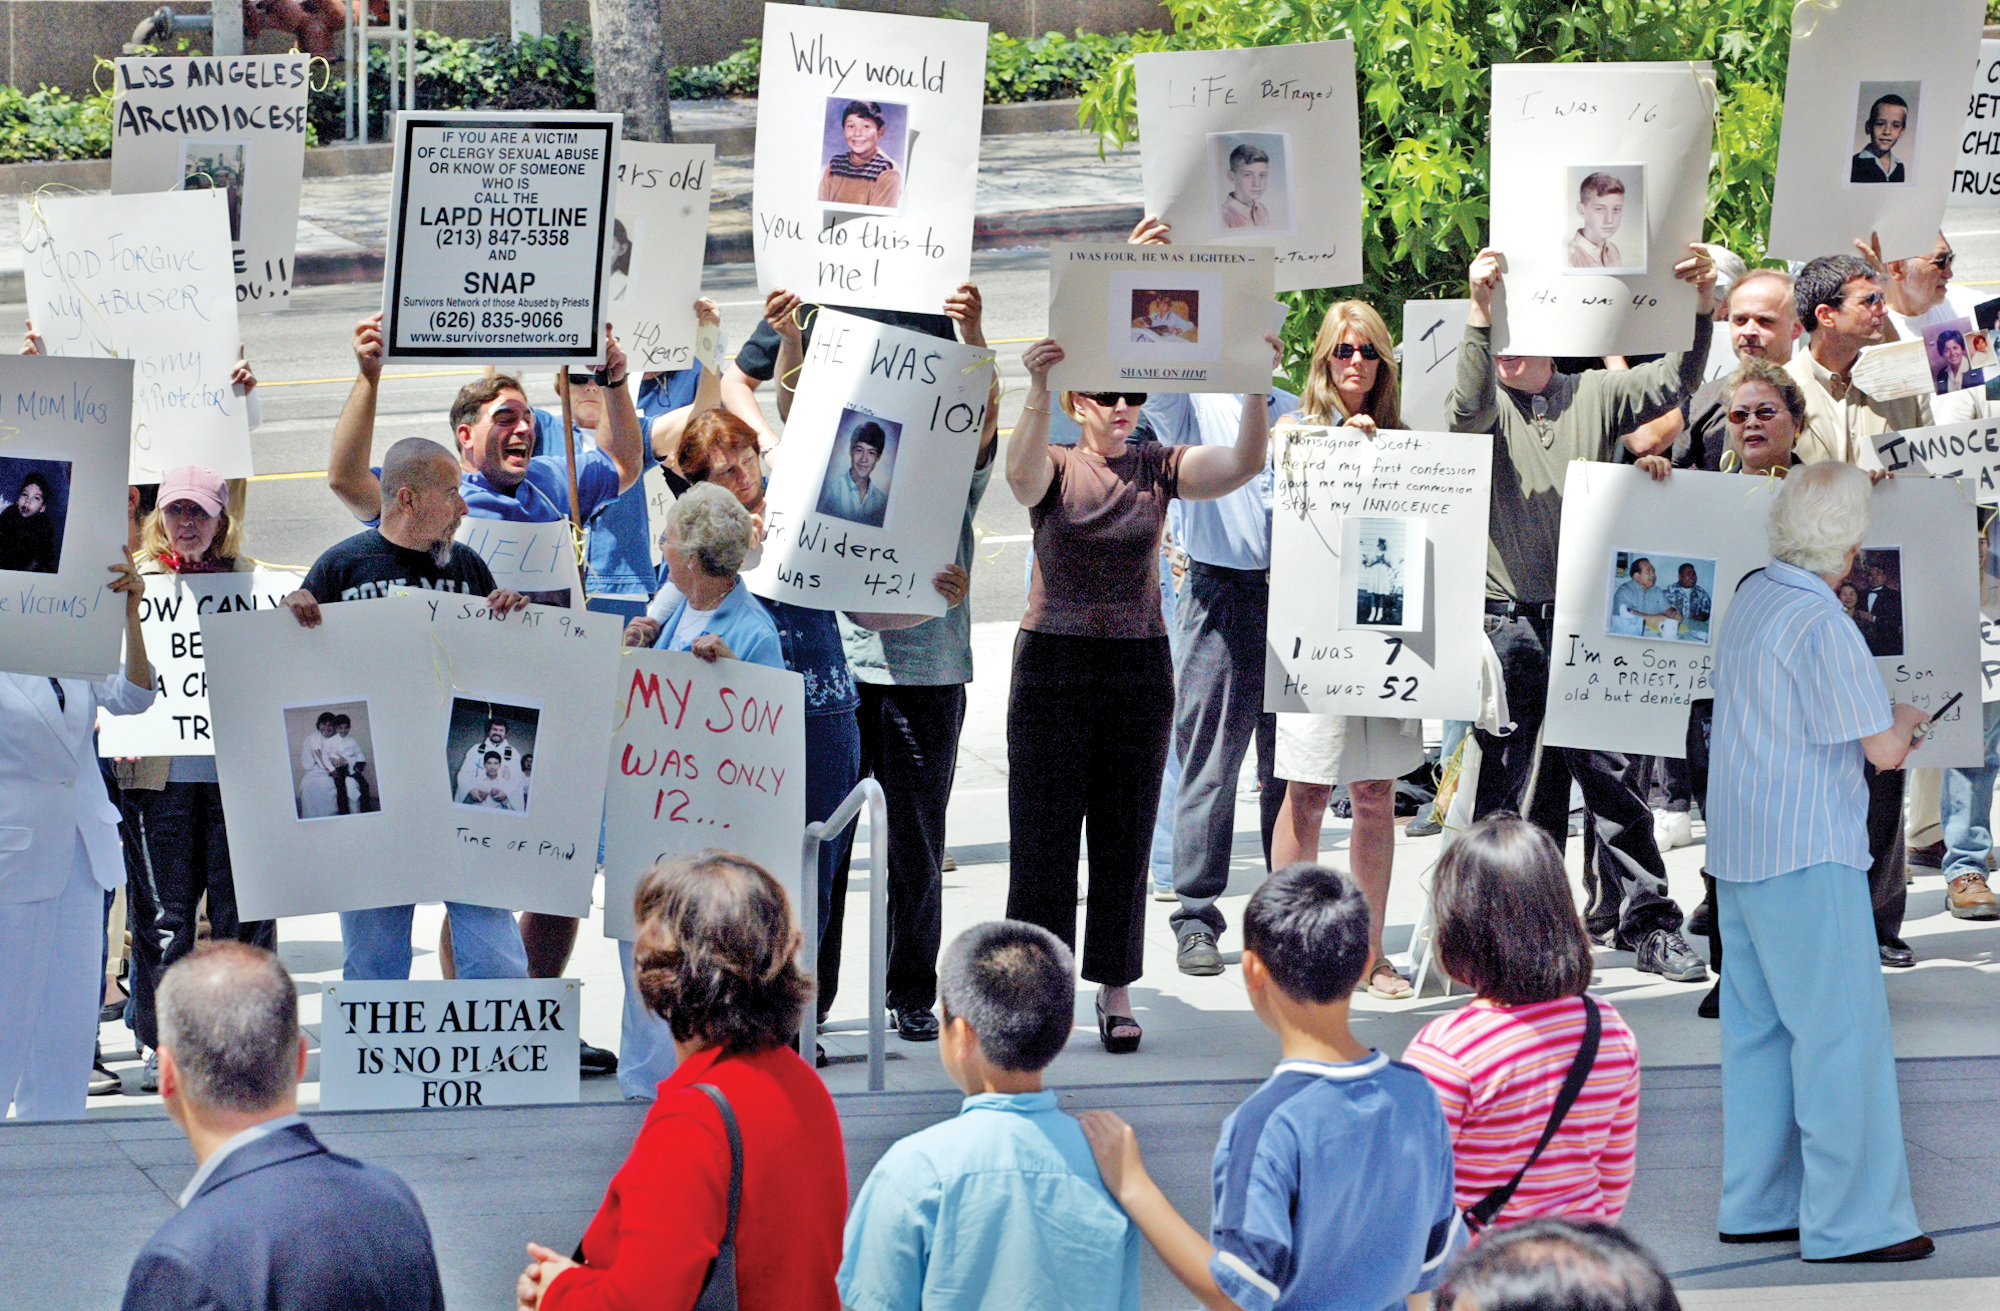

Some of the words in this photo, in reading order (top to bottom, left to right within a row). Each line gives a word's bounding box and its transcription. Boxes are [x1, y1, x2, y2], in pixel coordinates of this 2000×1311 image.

[790, 31, 857, 94] Why
[866, 56, 945, 93] would
[120, 63, 175, 90] LOS
[187, 60, 305, 88] ANGELES
[118, 100, 306, 136] ARCHDIOCESE
[1514, 91, 1543, 122] I
[1628, 102, 1657, 123] 16
[442, 132, 454, 143] IF
[458, 132, 486, 144] YOU
[490, 132, 517, 144] ARE
[521, 133, 530, 144] A
[535, 133, 578, 144] VICTIM
[417, 147, 436, 159] OF
[440, 147, 495, 159] CLERGY
[499, 148, 550, 160] SEXUAL
[555, 148, 599, 160] ABUSE
[429, 162, 449, 174] OR
[453, 163, 495, 174] KNOW
[499, 163, 517, 175] OF
[520, 163, 586, 176] SOMEONE
[618, 163, 663, 188] ars
[669, 159, 706, 191] old
[482, 178, 514, 189] WHO
[517, 178, 530, 189] IS
[474, 192, 509, 204] CALL
[513, 193, 539, 204] THE
[420, 207, 482, 226] LAPD
[490, 207, 588, 227] HOTLINE
[436, 228, 482, 249] (213)
[488, 229, 570, 246] 847-5358
[818, 216, 848, 246] do
[857, 222, 910, 250] this
[917, 226, 945, 259] to
[488, 249, 516, 261] AND
[1069, 252, 1073, 260] I
[1077, 252, 1101, 261] WAS
[1142, 253, 1157, 261] HE
[1160, 253, 1184, 262] WAS
[1190, 253, 1246, 263] EIGHTEEN
[236, 257, 289, 302] OU!!
[463, 272, 536, 294] SNAP
[403, 297, 444, 307] Survivors
[446, 297, 480, 308] Network
[482, 297, 491, 308] of
[492, 298, 515, 308] those
[517, 298, 548, 308] Abused
[550, 298, 560, 310] by
[562, 298, 590, 309] Priests
[1532, 289, 1557, 305] He
[1632, 294, 1657, 311] 40
[429, 311, 475, 332] (626)
[481, 311, 563, 328] 835-9066
[410, 331, 579, 345] www.survivorsnetwork.org
[633, 321, 661, 351] 40
[813, 327, 850, 364] HE
[870, 338, 941, 385] WAS
[1121, 368, 1160, 377] SHAME
[1162, 369, 1179, 377] ON
[1181, 369, 1207, 379] HIM!
[18, 391, 66, 421] MOM
[1338, 461, 1361, 478] my
[1372, 457, 1401, 474] first
[1410, 462, 1476, 476] confession
[1319, 480, 1335, 488] me
[1343, 481, 1362, 495] my
[1371, 477, 1400, 489] first
[1406, 482, 1472, 494] communion
[1331, 501, 1350, 515] my
[1363, 497, 1451, 514] INNOCENCE
[798, 520, 899, 564] Widera
[864, 572, 916, 599] 42!
[139, 595, 182, 622] OW
[521, 611, 544, 627] AT
[560, 616, 570, 637] 9
[1292, 636, 1302, 660] I
[1311, 643, 1354, 660] was
[1384, 638, 1403, 666] 7
[1565, 634, 1601, 666] I'm
[1614, 655, 1628, 667] a
[1642, 649, 1677, 669] Son
[1689, 655, 1711, 675] of
[1284, 674, 1310, 696] He
[1326, 683, 1365, 696] was
[1378, 675, 1419, 702] 52
[1588, 673, 1599, 685] a
[1619, 671, 1679, 689] PRIEST,
[626, 668, 692, 729] MY
[705, 687, 783, 735] SON
[1565, 688, 1589, 701] old
[1605, 687, 1633, 702] but
[1640, 691, 1691, 705] denied
[1912, 690, 1930, 709] by
[621, 743, 699, 780] WAS
[717, 758, 785, 796] ONLY
[507, 840, 528, 851] OF
[340, 1000, 427, 1034] THE
[436, 999, 565, 1033] ALTAR
[357, 1047, 384, 1075] IS
[393, 1046, 441, 1074] NO
[451, 1045, 548, 1073] PLACE
[421, 1080, 483, 1107] FOR
